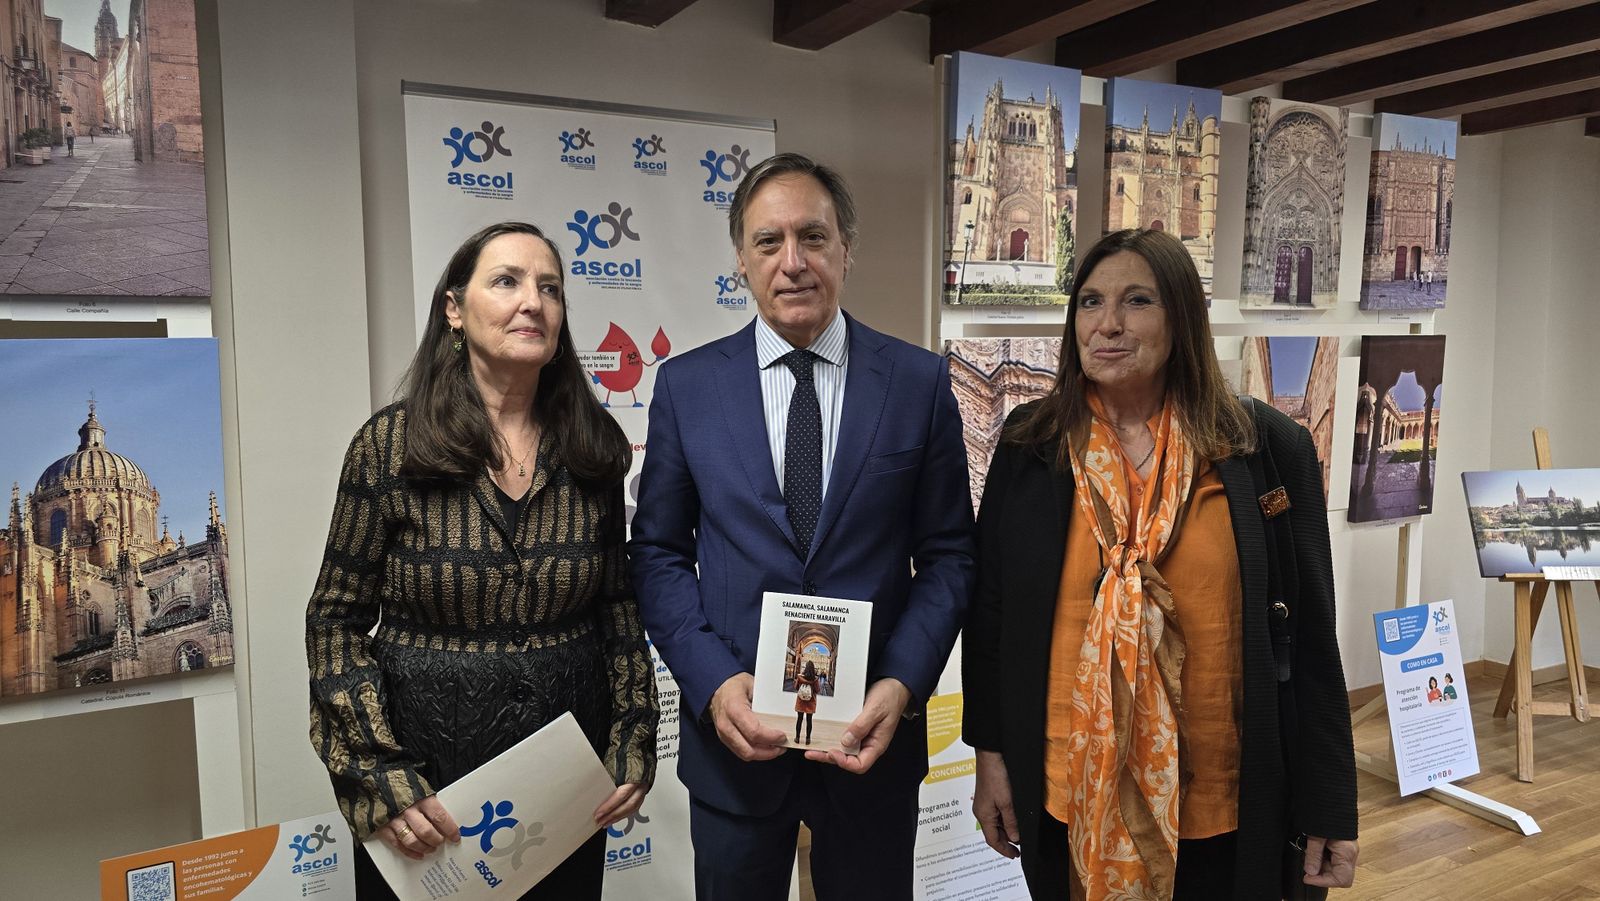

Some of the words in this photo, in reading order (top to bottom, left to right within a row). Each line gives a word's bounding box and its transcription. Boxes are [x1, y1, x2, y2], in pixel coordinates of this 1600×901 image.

[560, 154, 596, 164] ascol
[634, 160, 667, 170] ascol
[448, 172, 513, 189] ascol
[703, 190, 735, 203] asc
[571, 259, 642, 278] ascol
[716, 296, 747, 305] ascol
[782, 601, 815, 611] SALAMANCA,
[816, 604, 850, 614] SALAMANCA
[784, 610, 816, 620] RENACIENTE
[816, 614, 846, 623] MARAVILLA
[1434, 623, 1450, 632] ascol
[1407, 660, 1420, 669] COMO
[658, 690, 680, 698] 37007
[1396, 688, 1415, 696] Programa
[1402, 695, 1418, 703] atención
[660, 708, 679, 716] cyl.e
[1399, 702, 1422, 712] hospitalaria
[657, 734, 679, 742] col.cy
[658, 752, 678, 760] colcy
[930, 764, 974, 779] CONCIENCIA
[918, 802, 950, 814] Programa
[919, 810, 962, 826] oncienciación
[932, 823, 950, 834] social
[606, 837, 651, 862] scol
[182, 857, 203, 866] Desde
[205, 853, 220, 861] 1992
[220, 849, 238, 858] junto
[292, 852, 338, 873] ascol
[194, 862, 224, 873] personas
[184, 867, 231, 882] enfermedades
[474, 860, 503, 888] ascol
[184, 872, 248, 890] oncohematológicas
[197, 886, 224, 896] familias.
